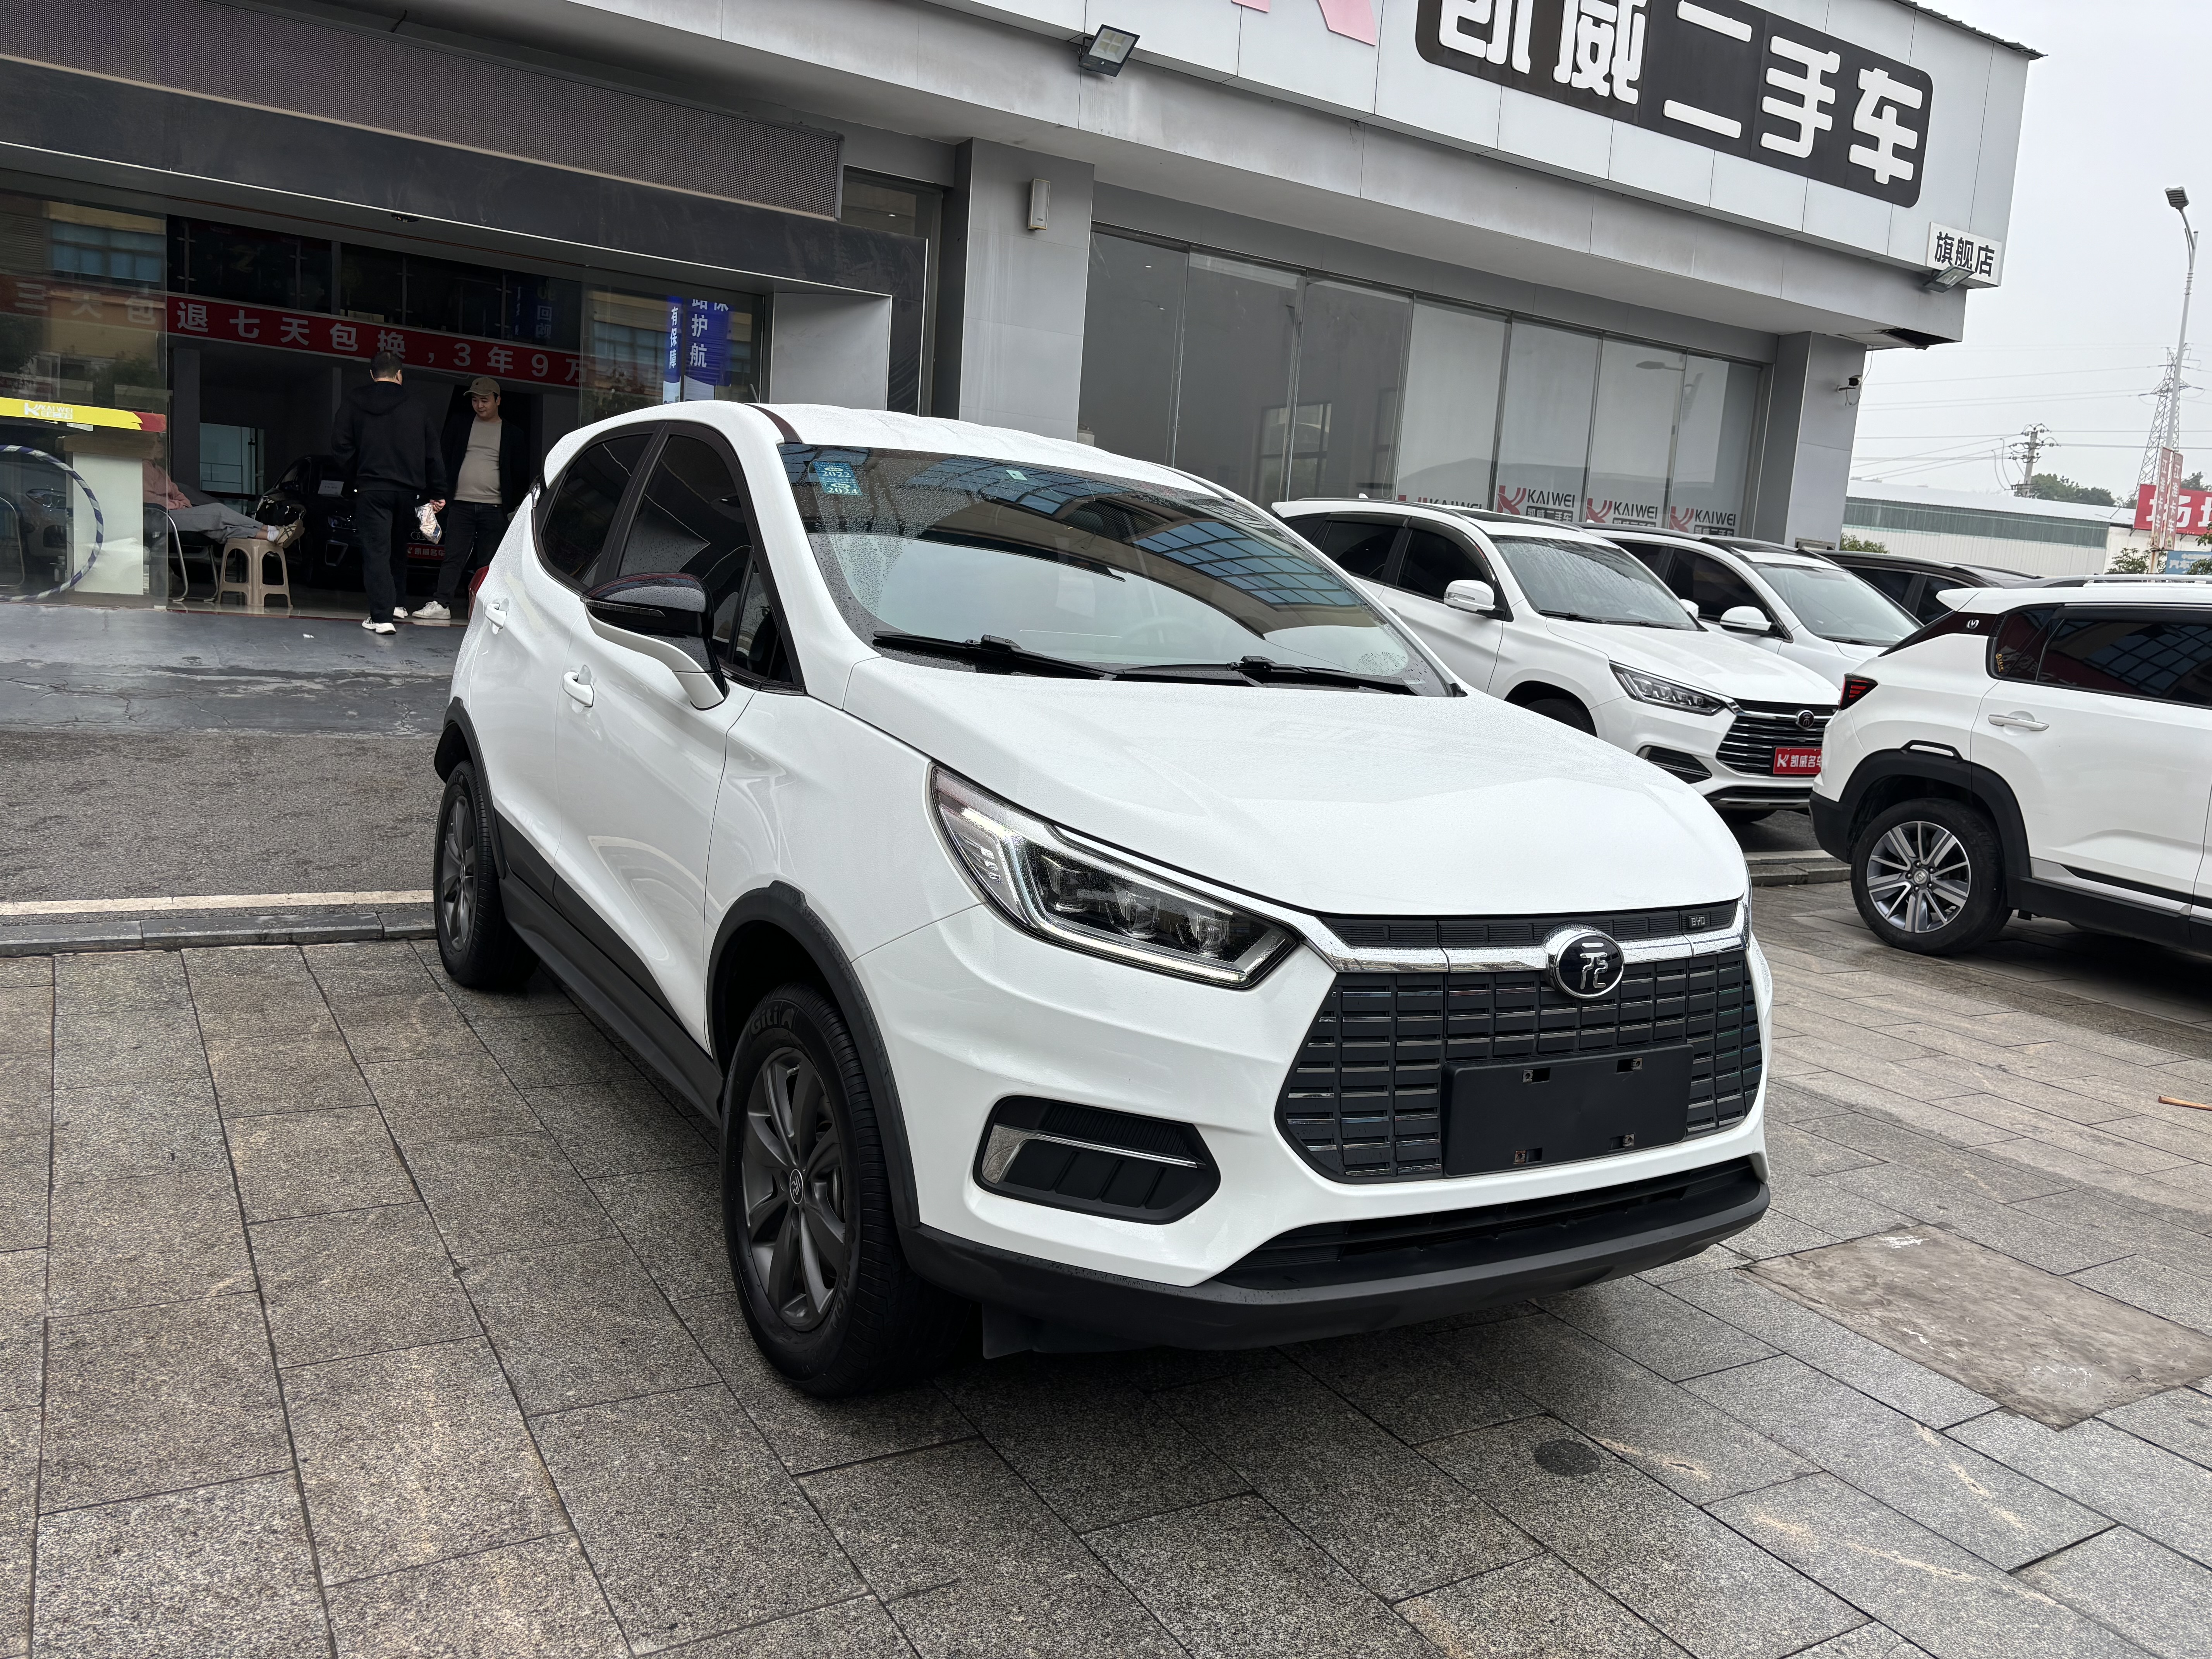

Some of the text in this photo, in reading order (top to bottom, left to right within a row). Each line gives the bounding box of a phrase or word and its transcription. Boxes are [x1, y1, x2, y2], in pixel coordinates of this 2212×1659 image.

[1934, 231, 1995, 277] 旗舰店
[669, 306, 678, 369] 有保障
[1527, 489, 1575, 508] KAIWEI
[1613, 501, 1658, 519] KAIWEI
[2167, 464, 2181, 534] 江淮卡车
[1695, 509, 1736, 526] KAIWEI
[1691, 916, 1705, 926] BYD
[750, 1006, 778, 1035] Giti
